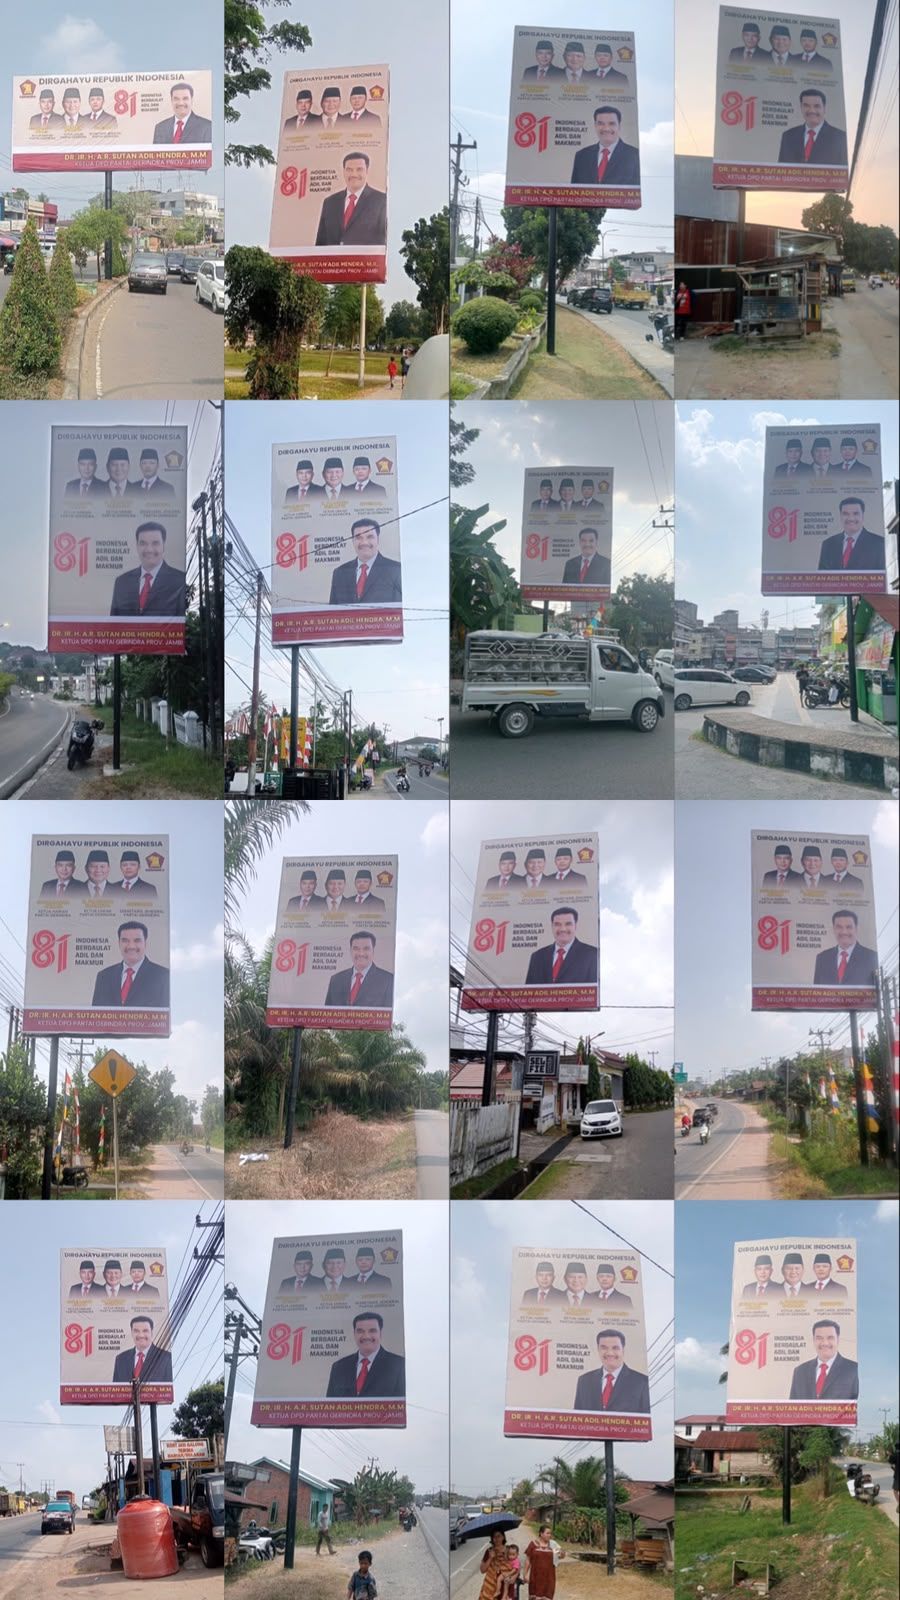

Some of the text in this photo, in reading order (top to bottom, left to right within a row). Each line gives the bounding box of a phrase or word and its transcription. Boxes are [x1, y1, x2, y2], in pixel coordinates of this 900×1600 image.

[39, 73, 185, 85] DIRGAHAYU REPUBLIK INDONESIA
[114, 89, 138, 118] 81
[721, 92, 756, 129] 81
[514, 112, 550, 151] 81
[280, 166, 307, 199] 81
[278, 447, 318, 455] DIRGAHAYU
[768, 508, 798, 540] 81
[54, 532, 91, 576] 81
[276, 532, 311, 572] 81
[526, 534, 550, 560] 81
[32, 930, 70, 972] 81
[474, 918, 508, 955] 81
[757, 915, 792, 954] 81
[275, 939, 310, 976] 81
[278, 1241, 320, 1249] DIRGAHAYU
[64, 1323, 94, 1356] 81
[267, 1324, 304, 1364] 81
[514, 1335, 552, 1375] 81
[735, 1329, 770, 1369] 81
